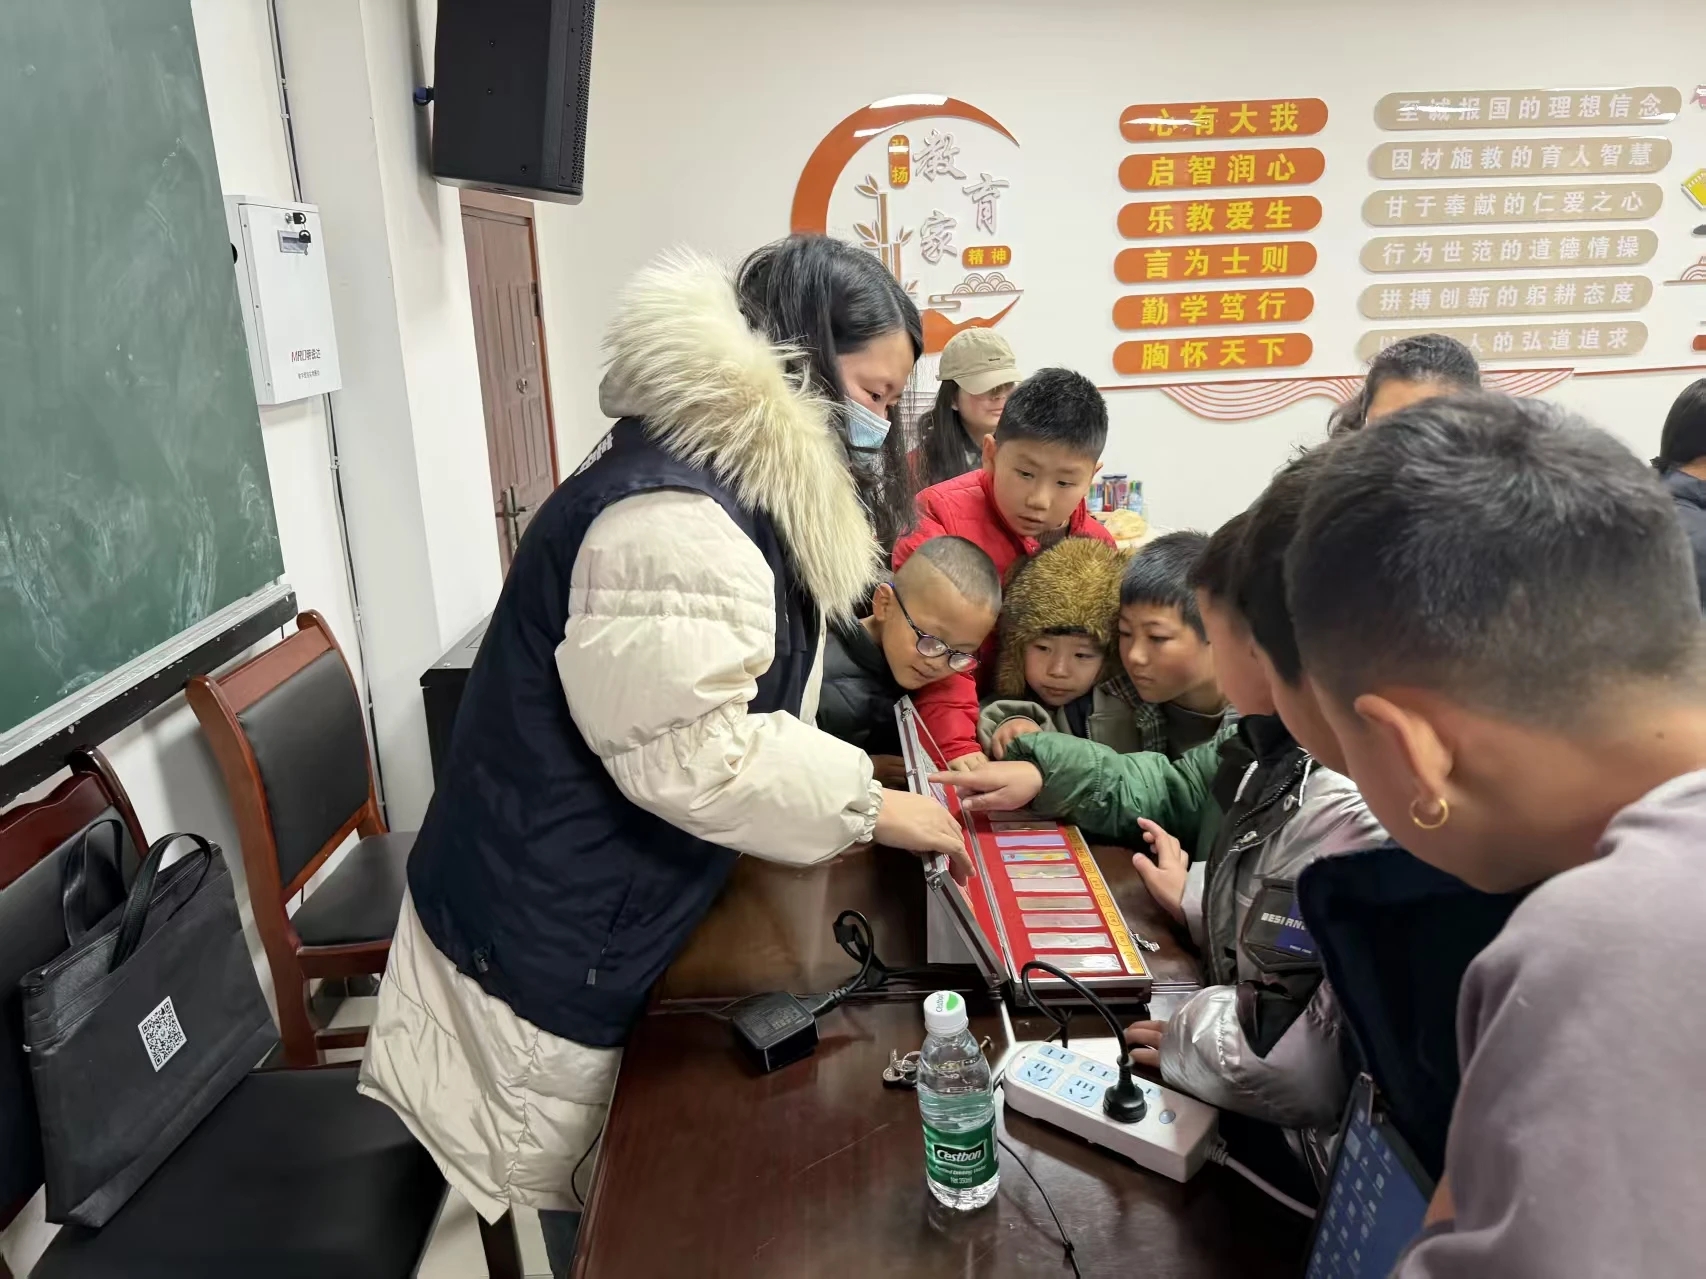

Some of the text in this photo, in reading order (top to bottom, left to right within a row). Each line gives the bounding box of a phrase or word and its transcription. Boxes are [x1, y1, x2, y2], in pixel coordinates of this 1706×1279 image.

[1149, 100, 1300, 137] 心有大我
[1147, 152, 1296, 187] 启智润心
[1391, 142, 1653, 172] 因材施教的育人智慧
[1147, 201, 1293, 235] 乐教爱生
[1385, 190, 1644, 218] 甘于奉献的仁爱之心
[968, 249, 1007, 265] 精神
[1144, 244, 1289, 280] 言为士则
[1383, 235, 1640, 265] 行为世范的道德情操
[1141, 288, 1286, 325] 勤学笃行
[1380, 282, 1634, 311] 拼搏创新的躬耕态度
[1142, 336, 1285, 371] 胸怀天下
